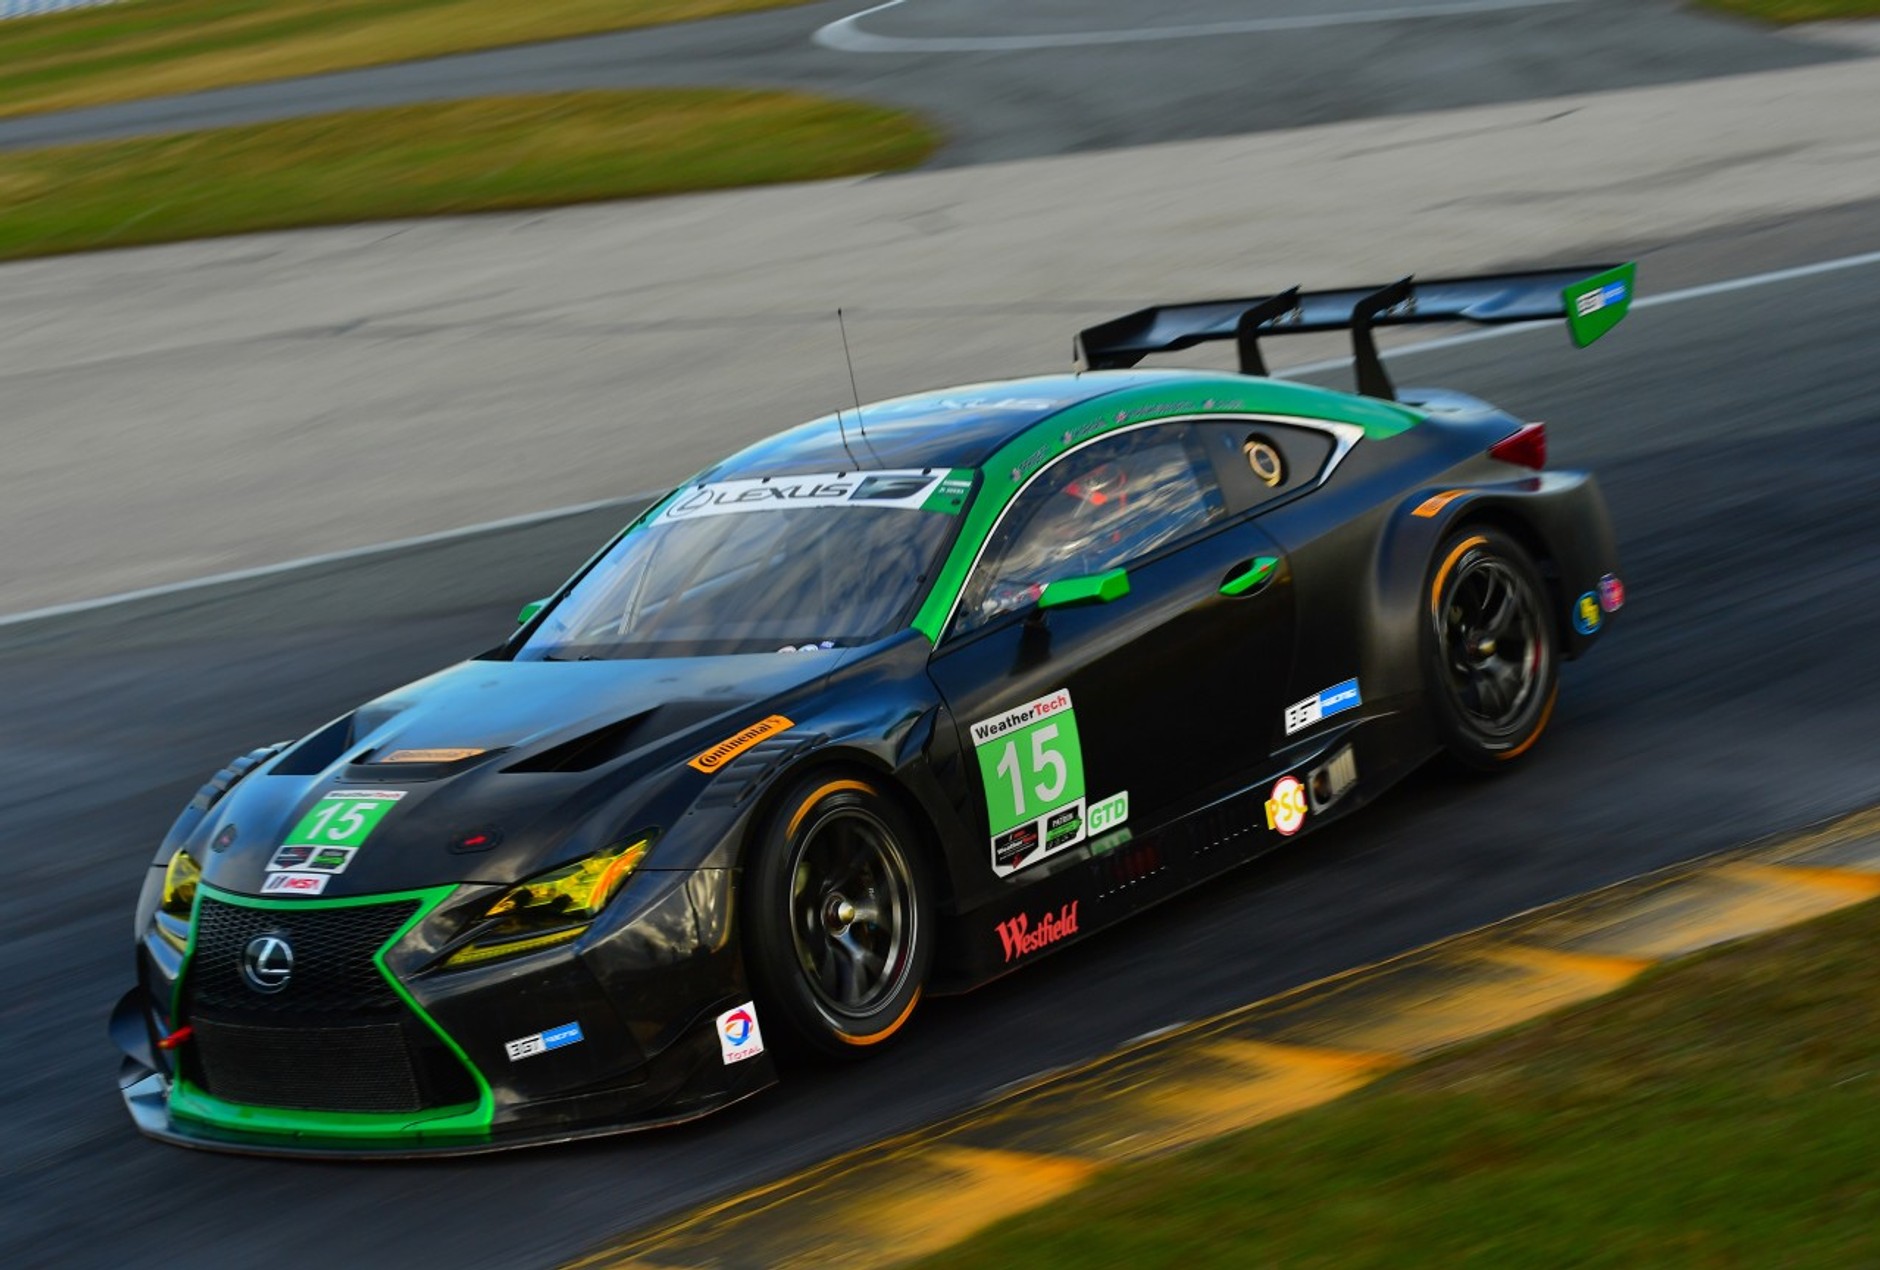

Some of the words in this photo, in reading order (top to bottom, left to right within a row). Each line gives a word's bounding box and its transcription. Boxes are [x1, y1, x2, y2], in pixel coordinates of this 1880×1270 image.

[713, 482, 853, 506] LEXUS
[975, 695, 1068, 739] WeatherTech
[699, 723, 772, 767] Continental
[997, 723, 1067, 816] 15
[306, 802, 379, 841] 15
[1090, 798, 1126, 829] GTD
[994, 900, 1079, 963] Westfield
[726, 1046, 762, 1062] TOTAL
